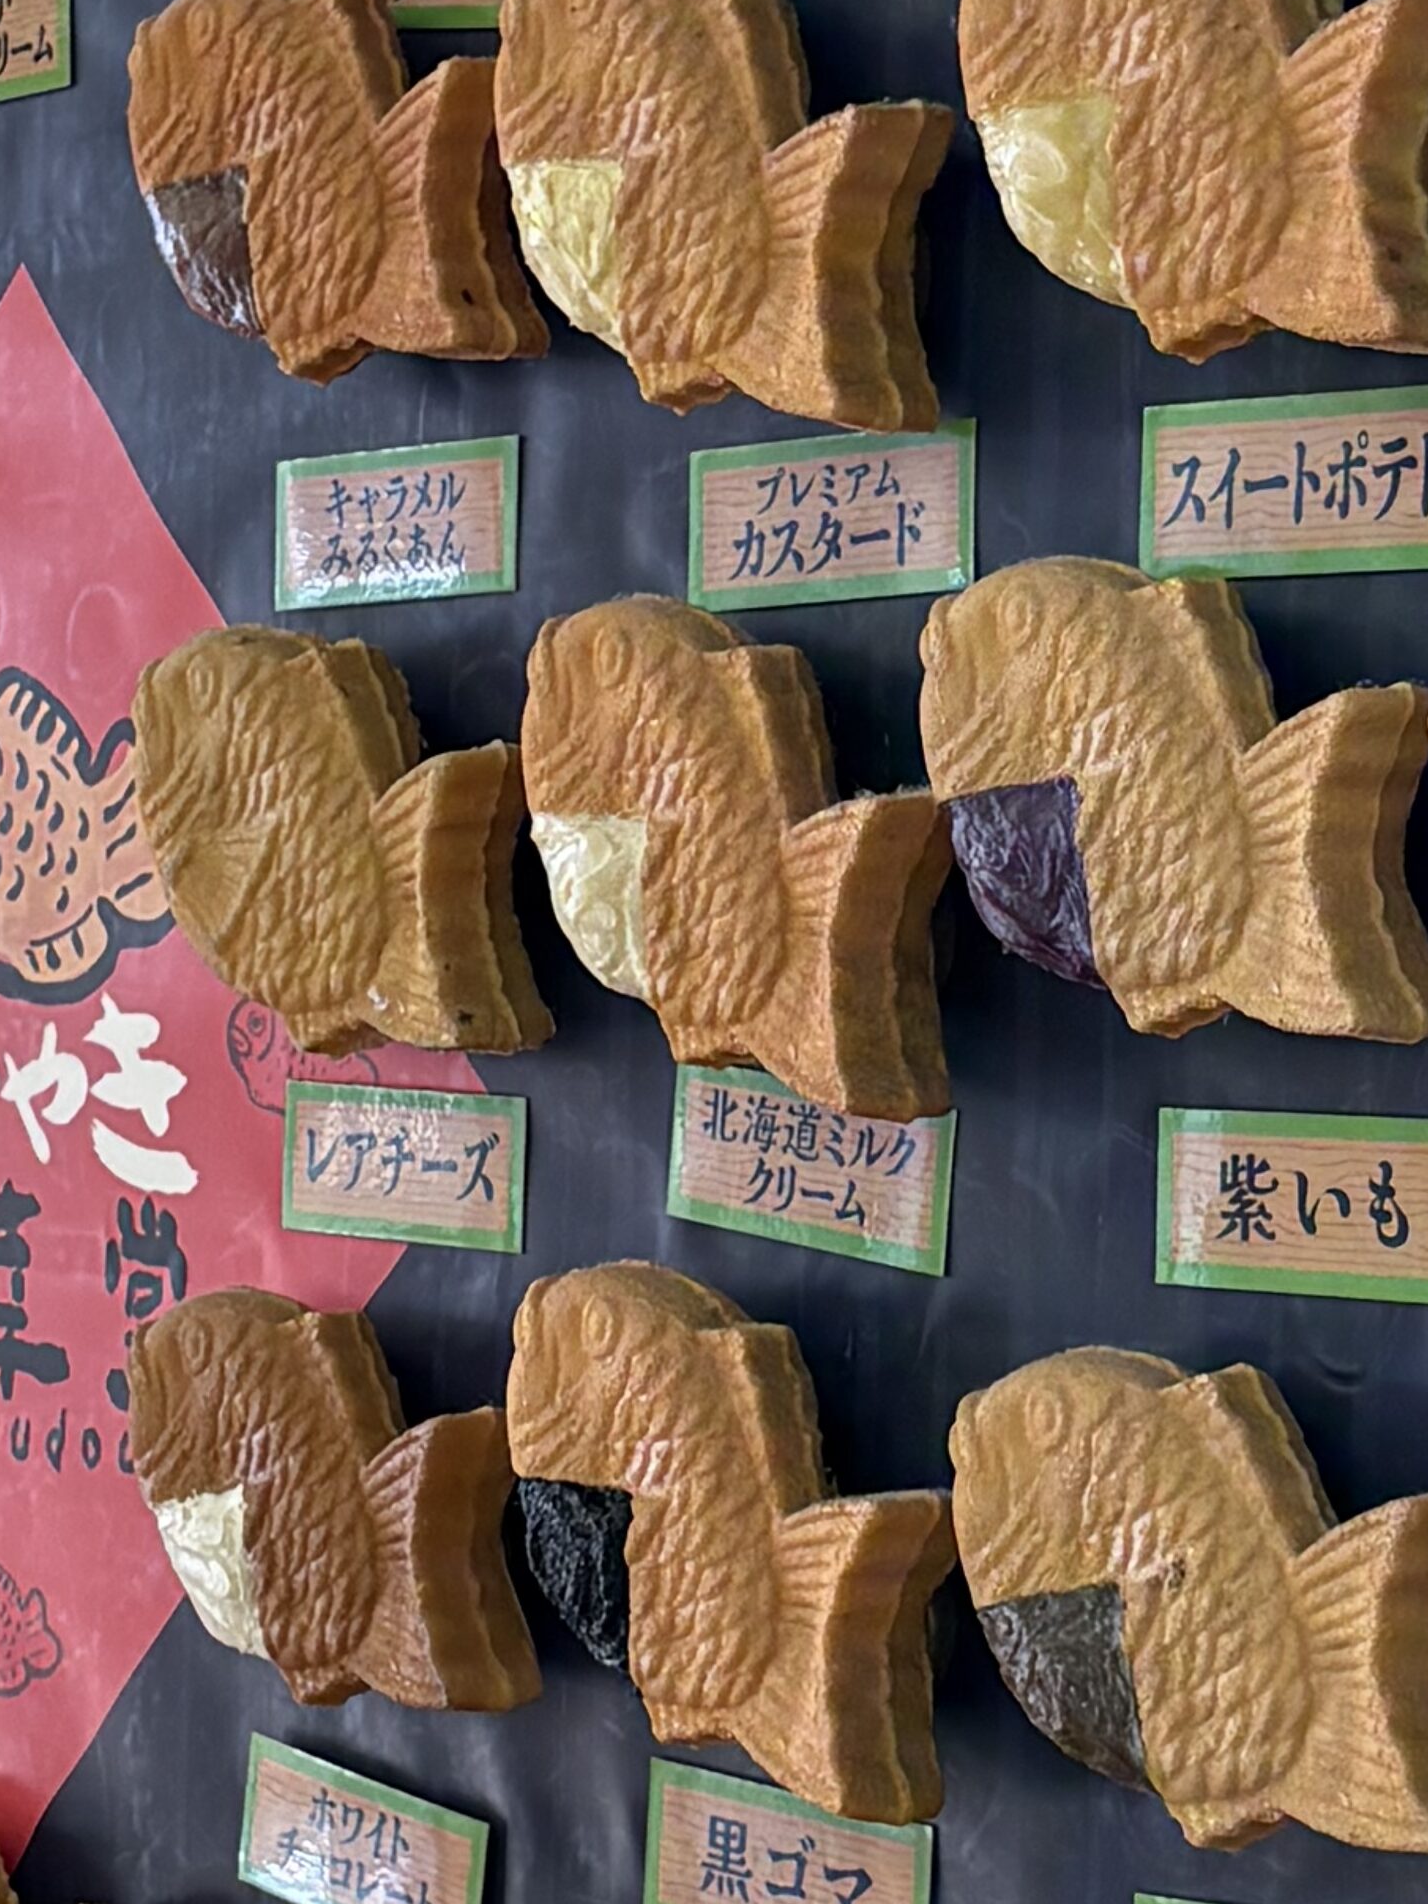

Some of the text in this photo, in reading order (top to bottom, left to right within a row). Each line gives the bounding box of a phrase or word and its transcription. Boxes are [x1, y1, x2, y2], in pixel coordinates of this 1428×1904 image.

[328, 471, 466, 528] キャラメル
[756, 460, 901, 516] プレミアム
[729, 503, 924, 581] カスタード
[305, 1128, 498, 1203] レアチーズ
[703, 1089, 917, 1177] 北海道ミルク
[746, 1158, 865, 1226] クリーム
[1216, 1153, 1409, 1249] 紫いも
[309, 1787, 409, 1864] ホワイト
